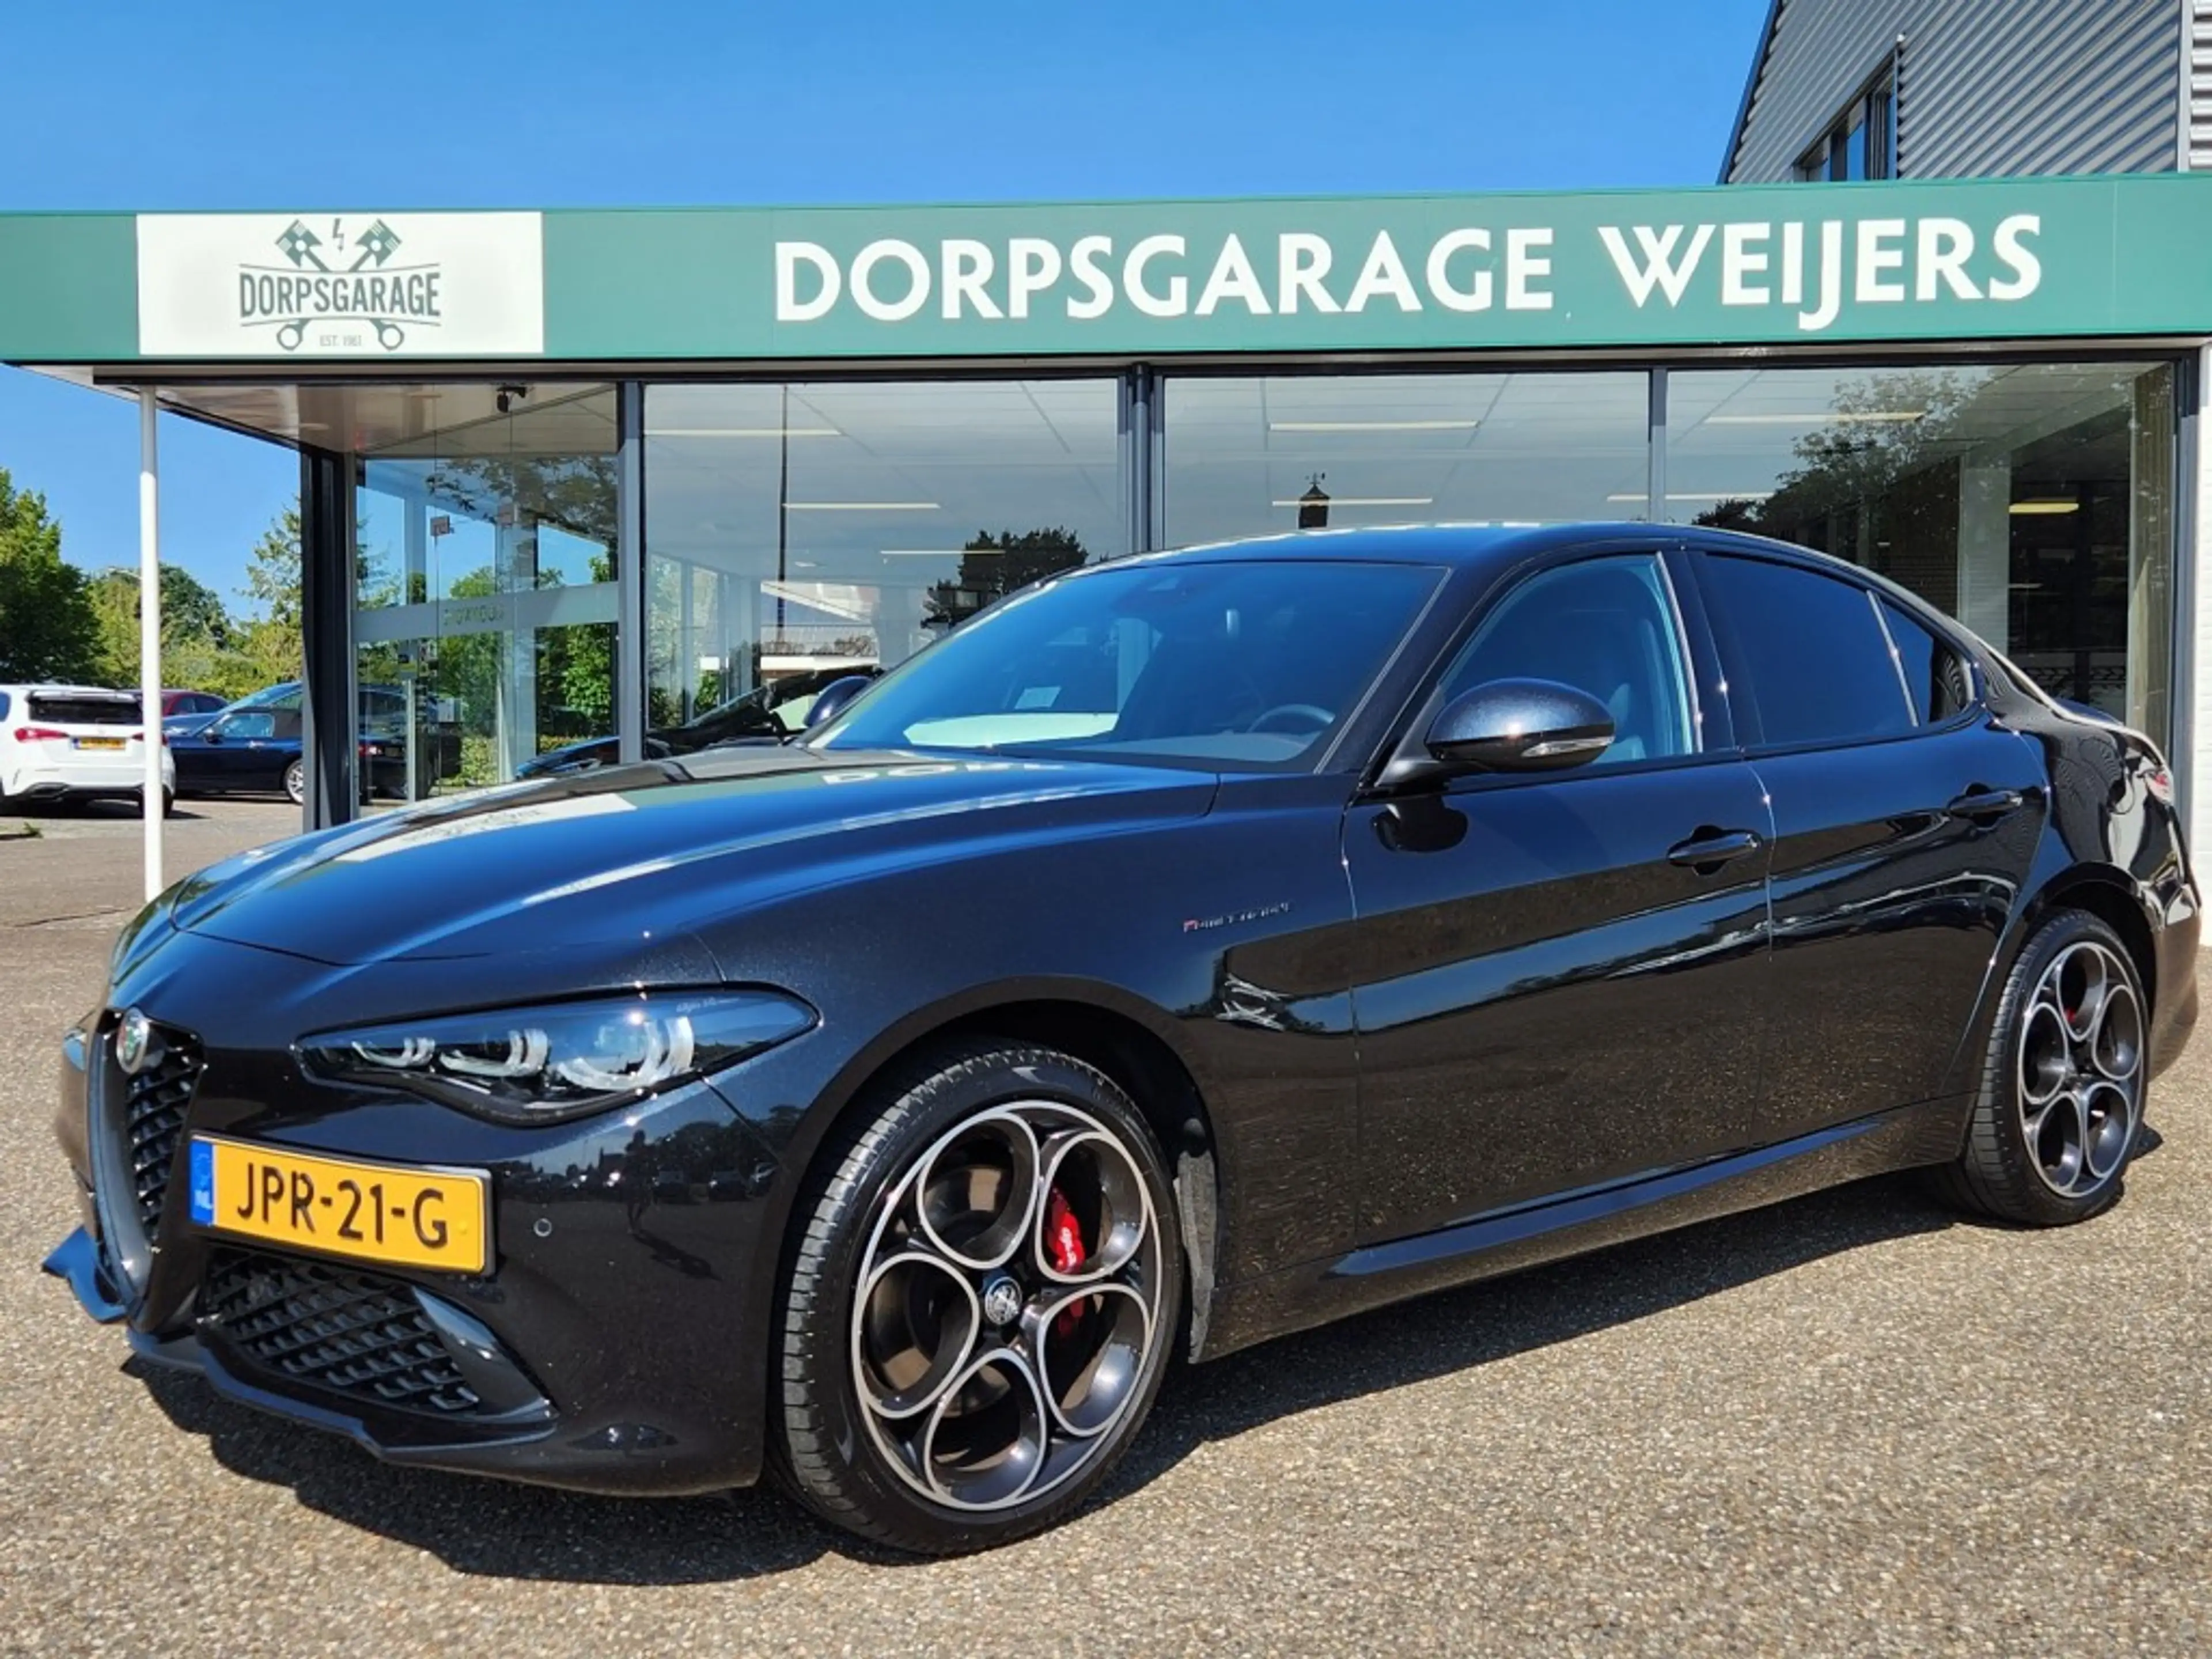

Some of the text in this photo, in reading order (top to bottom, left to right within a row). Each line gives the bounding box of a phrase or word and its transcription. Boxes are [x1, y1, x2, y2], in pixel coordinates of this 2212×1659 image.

[239, 272, 441, 318] DORPSGARAGE
[775, 214, 2041, 331] DORPSGARAGE WEIJERS
[237, 1162, 448, 1249] JPR-21-G
